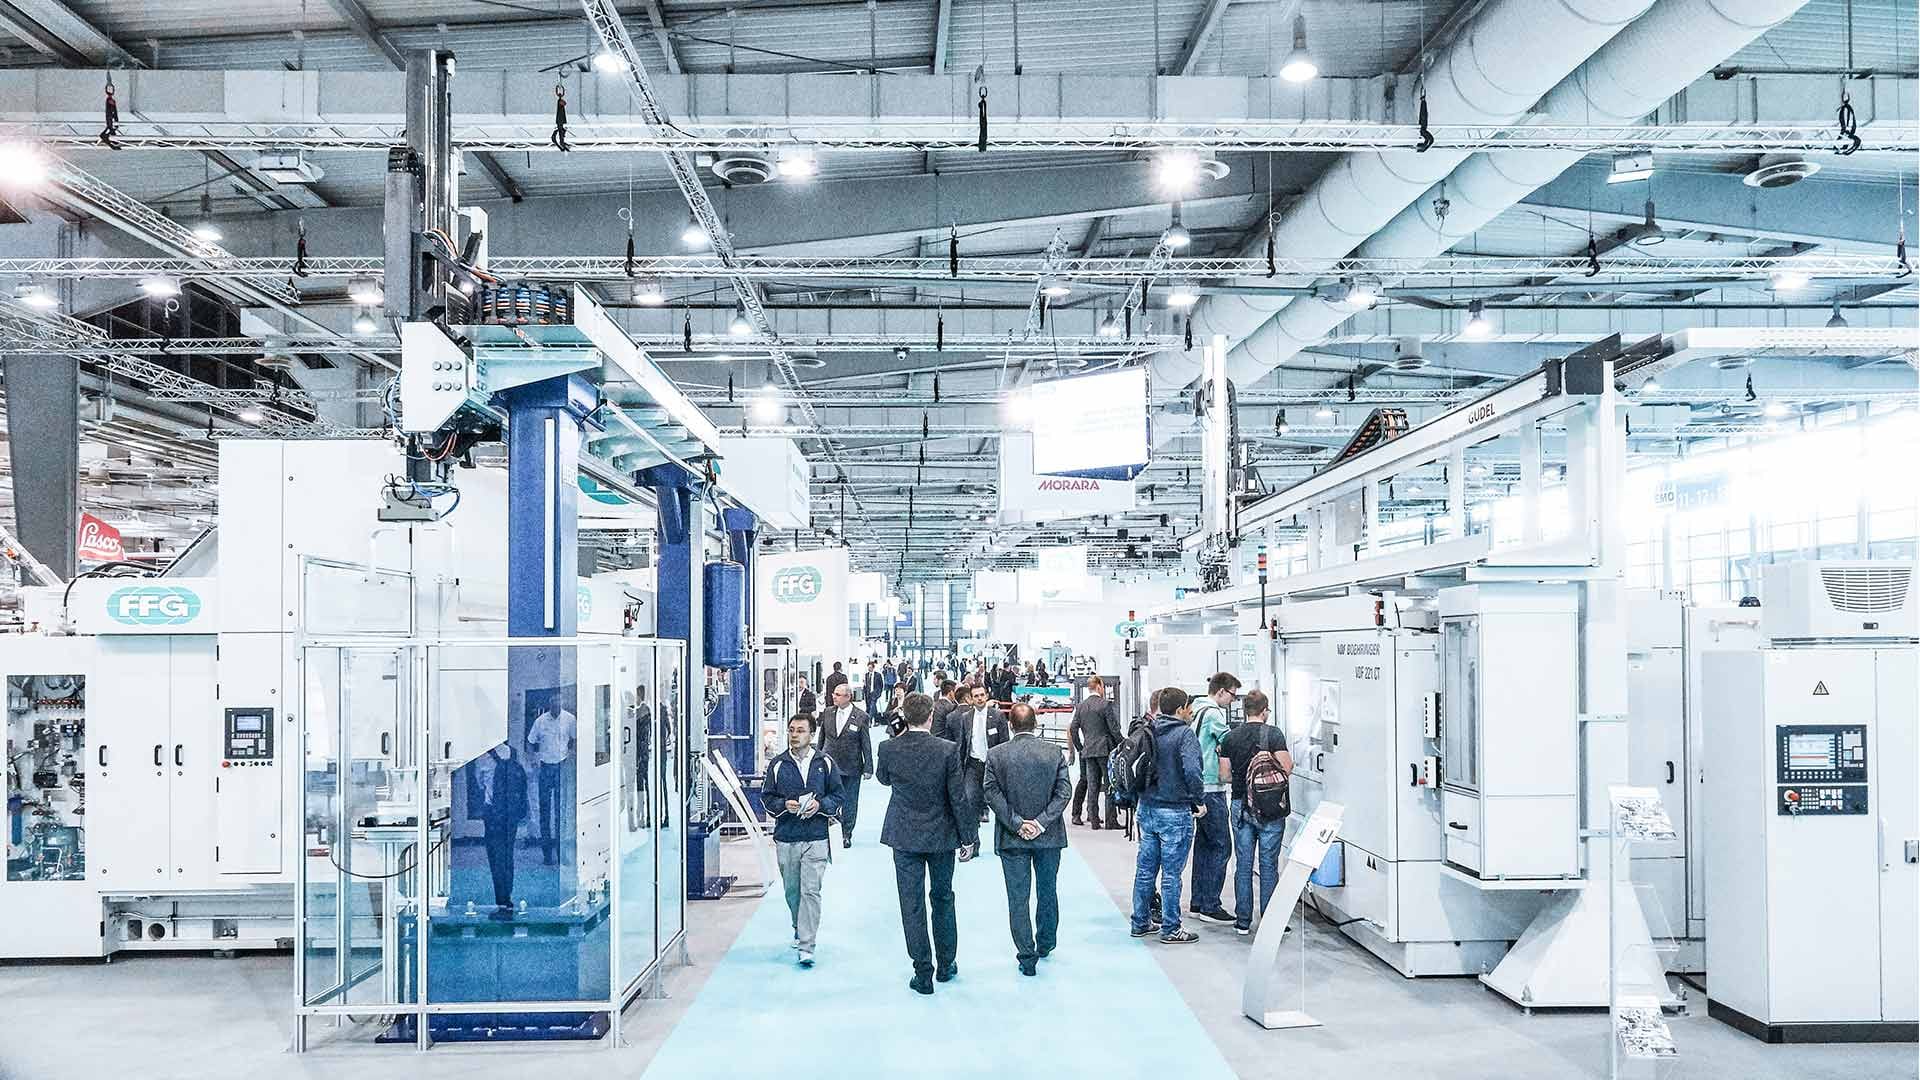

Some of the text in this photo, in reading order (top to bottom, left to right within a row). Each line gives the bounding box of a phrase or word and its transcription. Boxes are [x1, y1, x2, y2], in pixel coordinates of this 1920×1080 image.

[1038, 480, 1100, 490] MORARA
[778, 573, 816, 595] FFG
[119, 595, 188, 617] FFG
